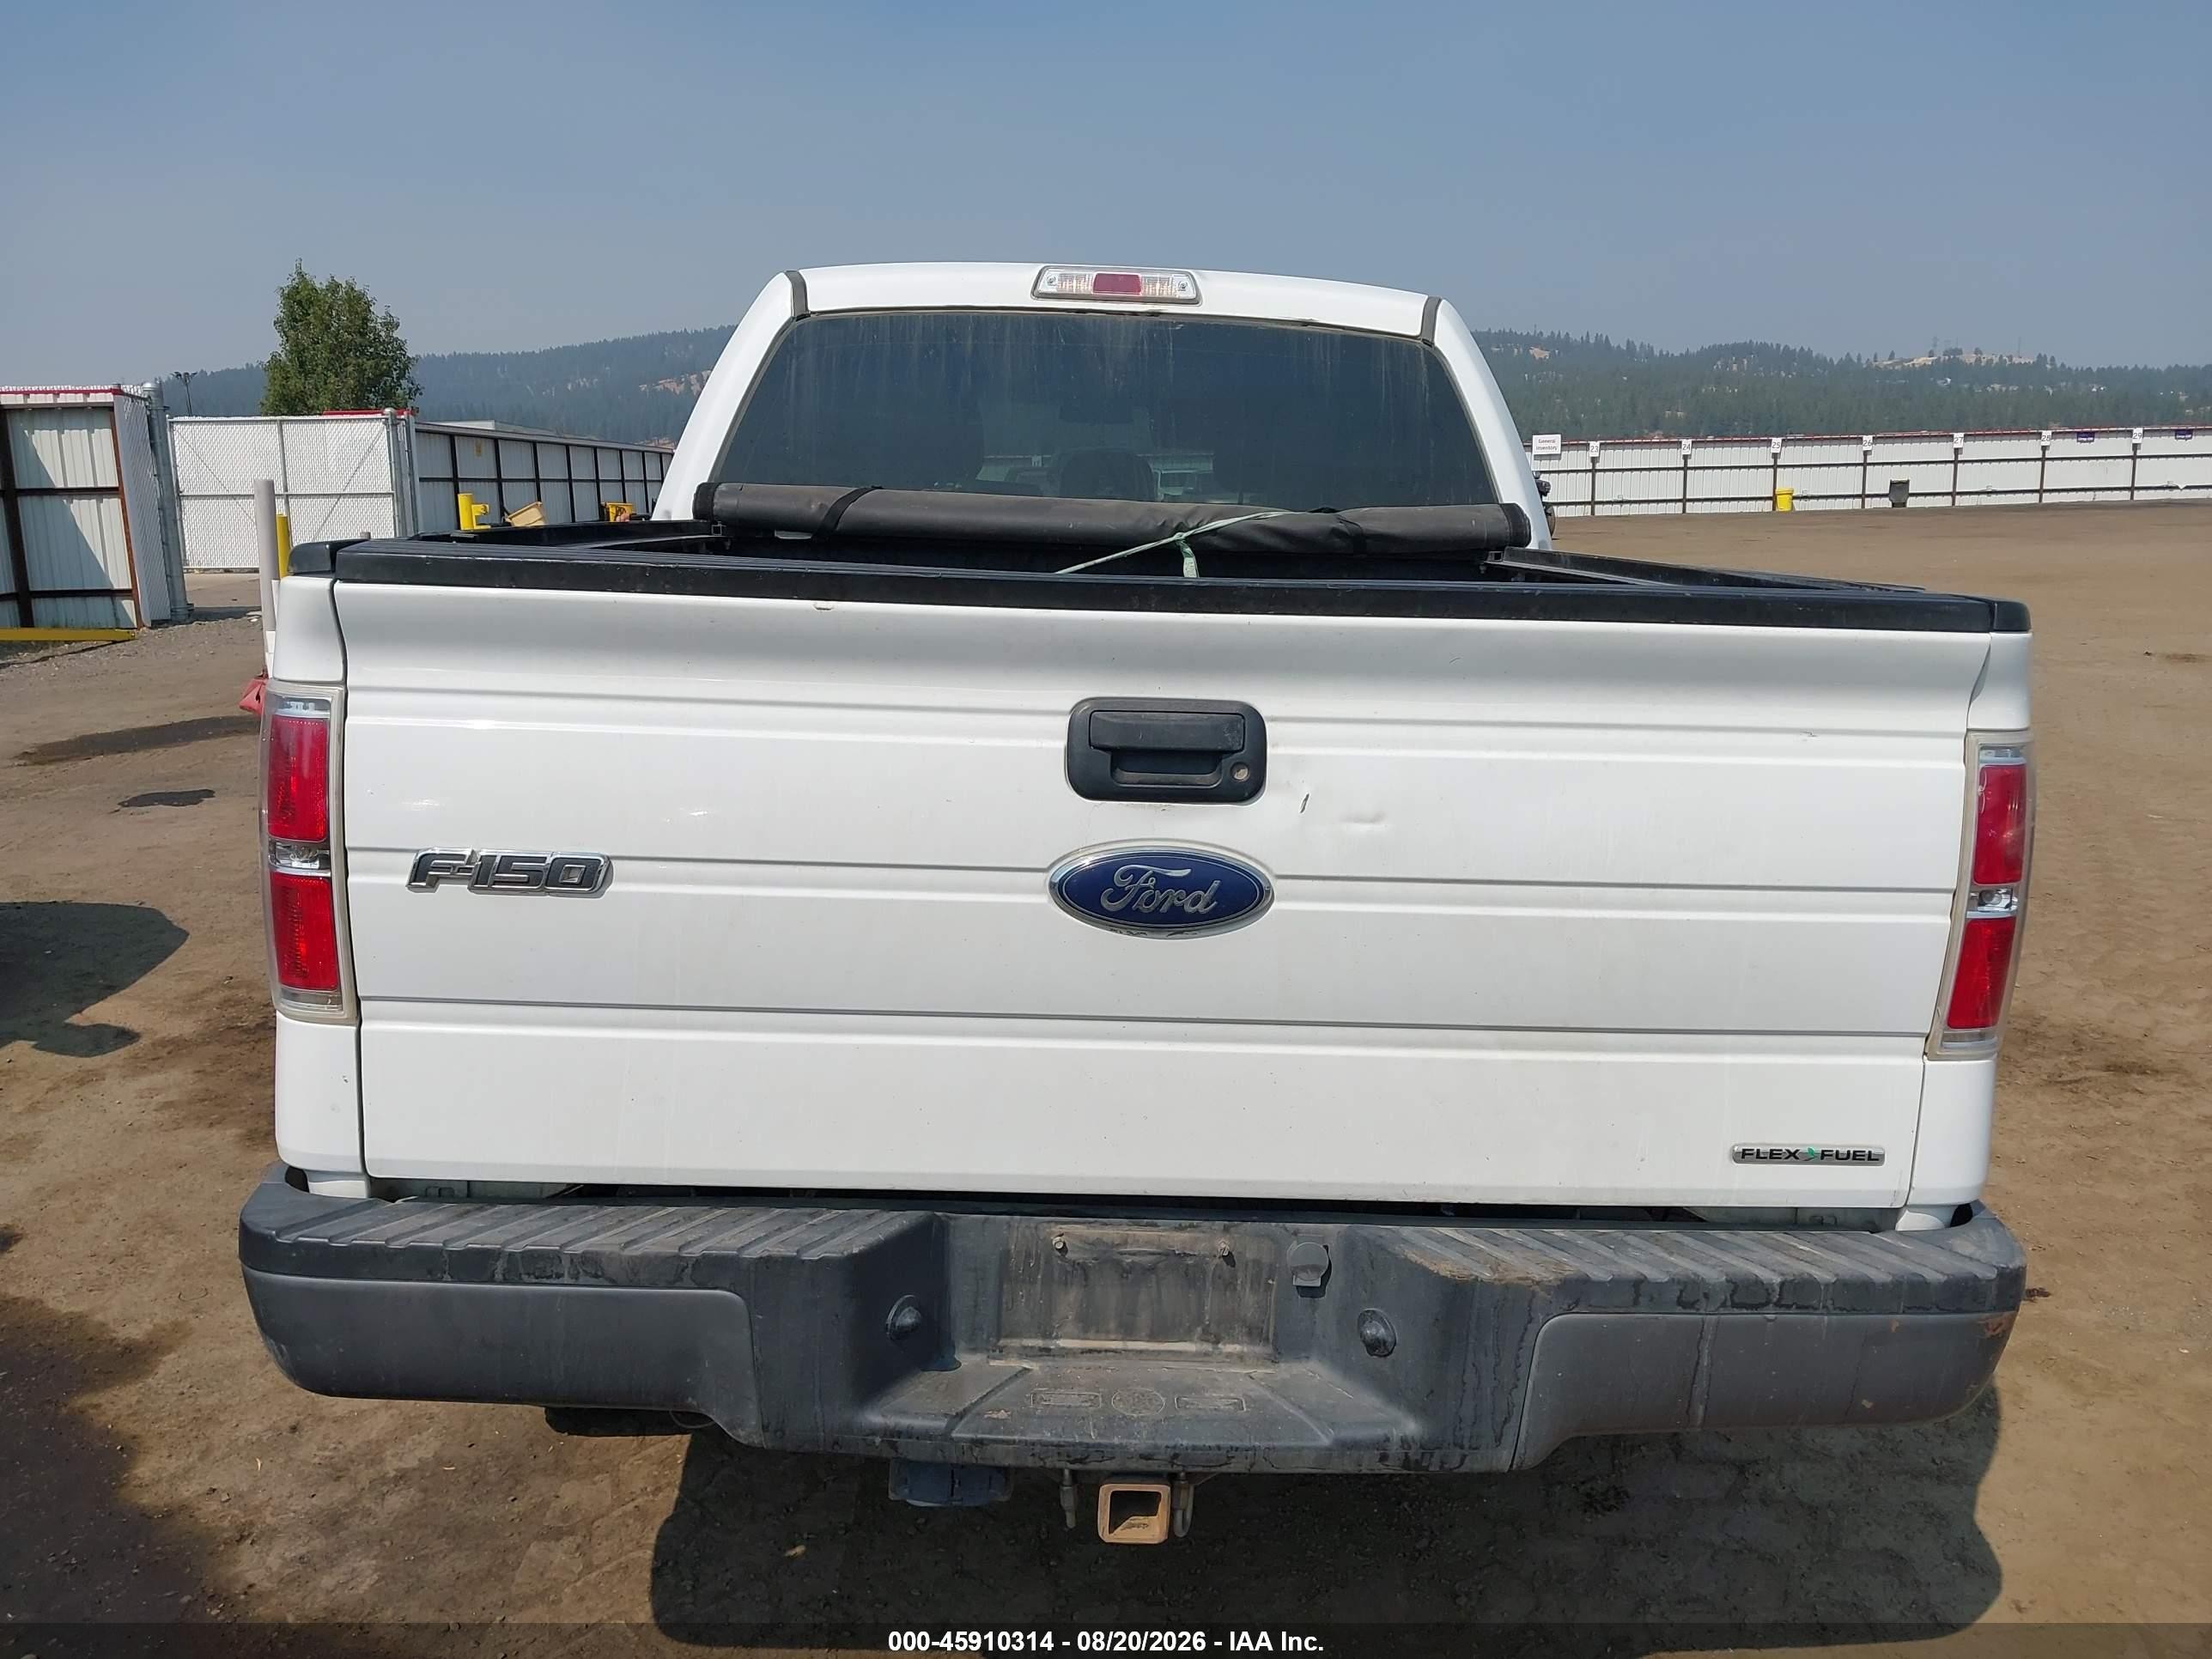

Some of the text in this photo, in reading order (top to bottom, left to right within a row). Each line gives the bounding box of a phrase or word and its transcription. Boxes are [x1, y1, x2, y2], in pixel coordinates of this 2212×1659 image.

[1863, 439, 1872, 447] 26
[406, 845, 613, 898] F-150
[1100, 864, 1222, 915] Ford
[1741, 1148, 1880, 1161] FLEX FUEL
